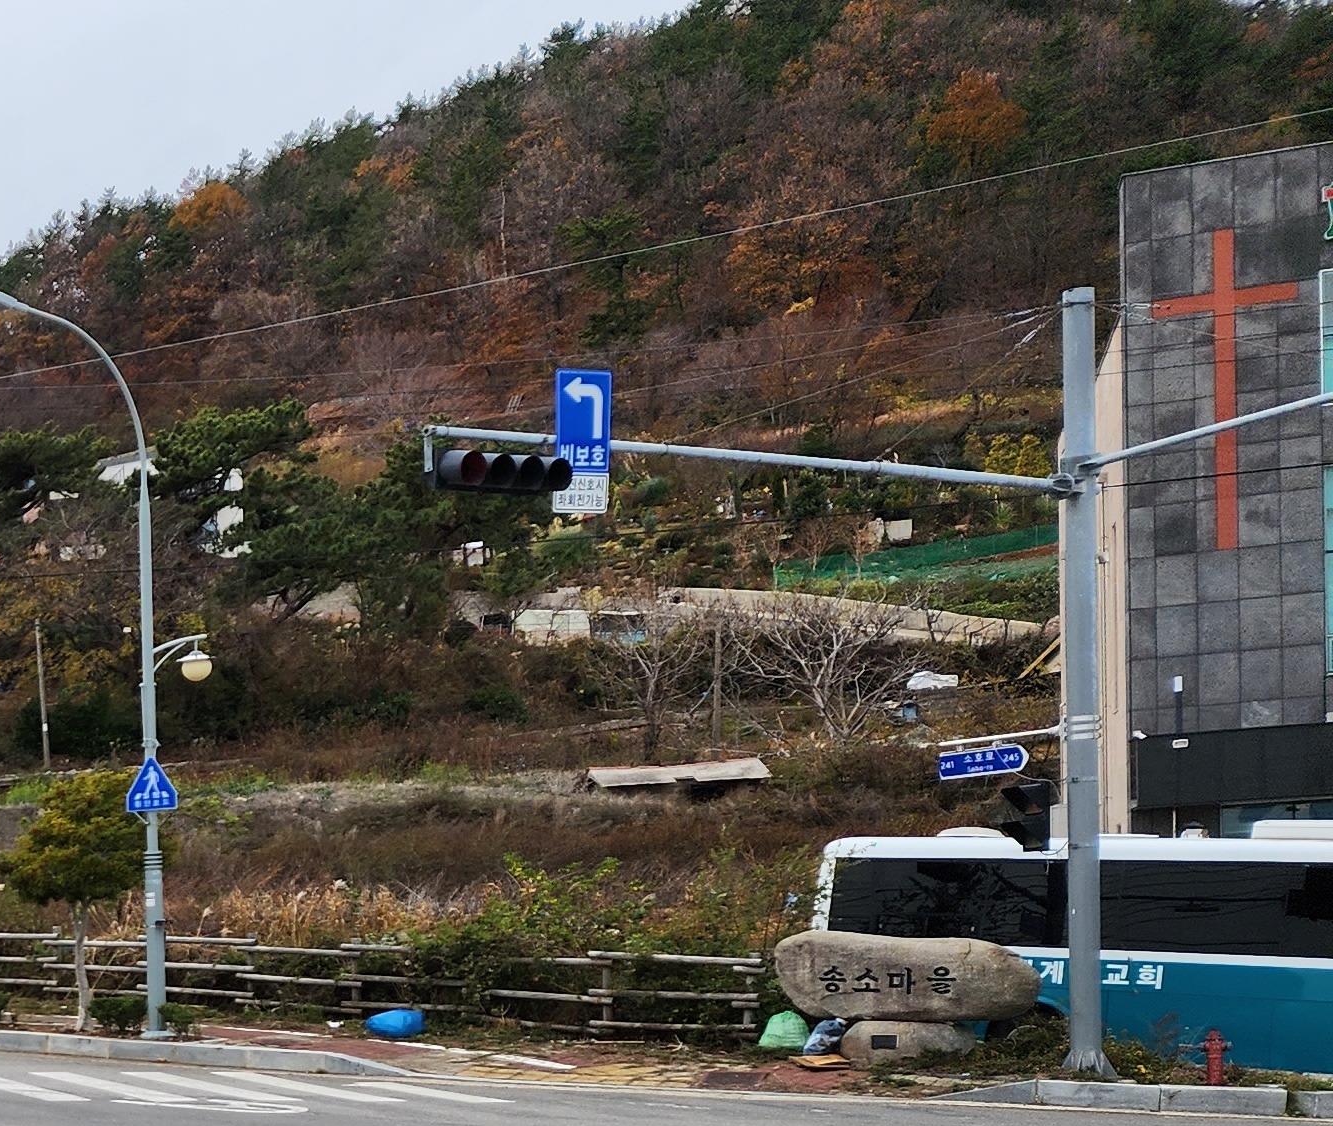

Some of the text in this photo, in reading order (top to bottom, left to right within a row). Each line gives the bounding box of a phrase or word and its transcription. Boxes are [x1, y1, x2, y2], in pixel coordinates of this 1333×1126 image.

[560, 443, 606, 467] 비보호
[569, 478, 605, 491] 진신호시
[558, 493, 603, 508] 좌회전가능
[963, 751, 996, 764] 소호로
[1003, 752, 1020, 763] 245
[940, 760, 955, 770] 241
[819, 965, 958, 996] 송소마을
